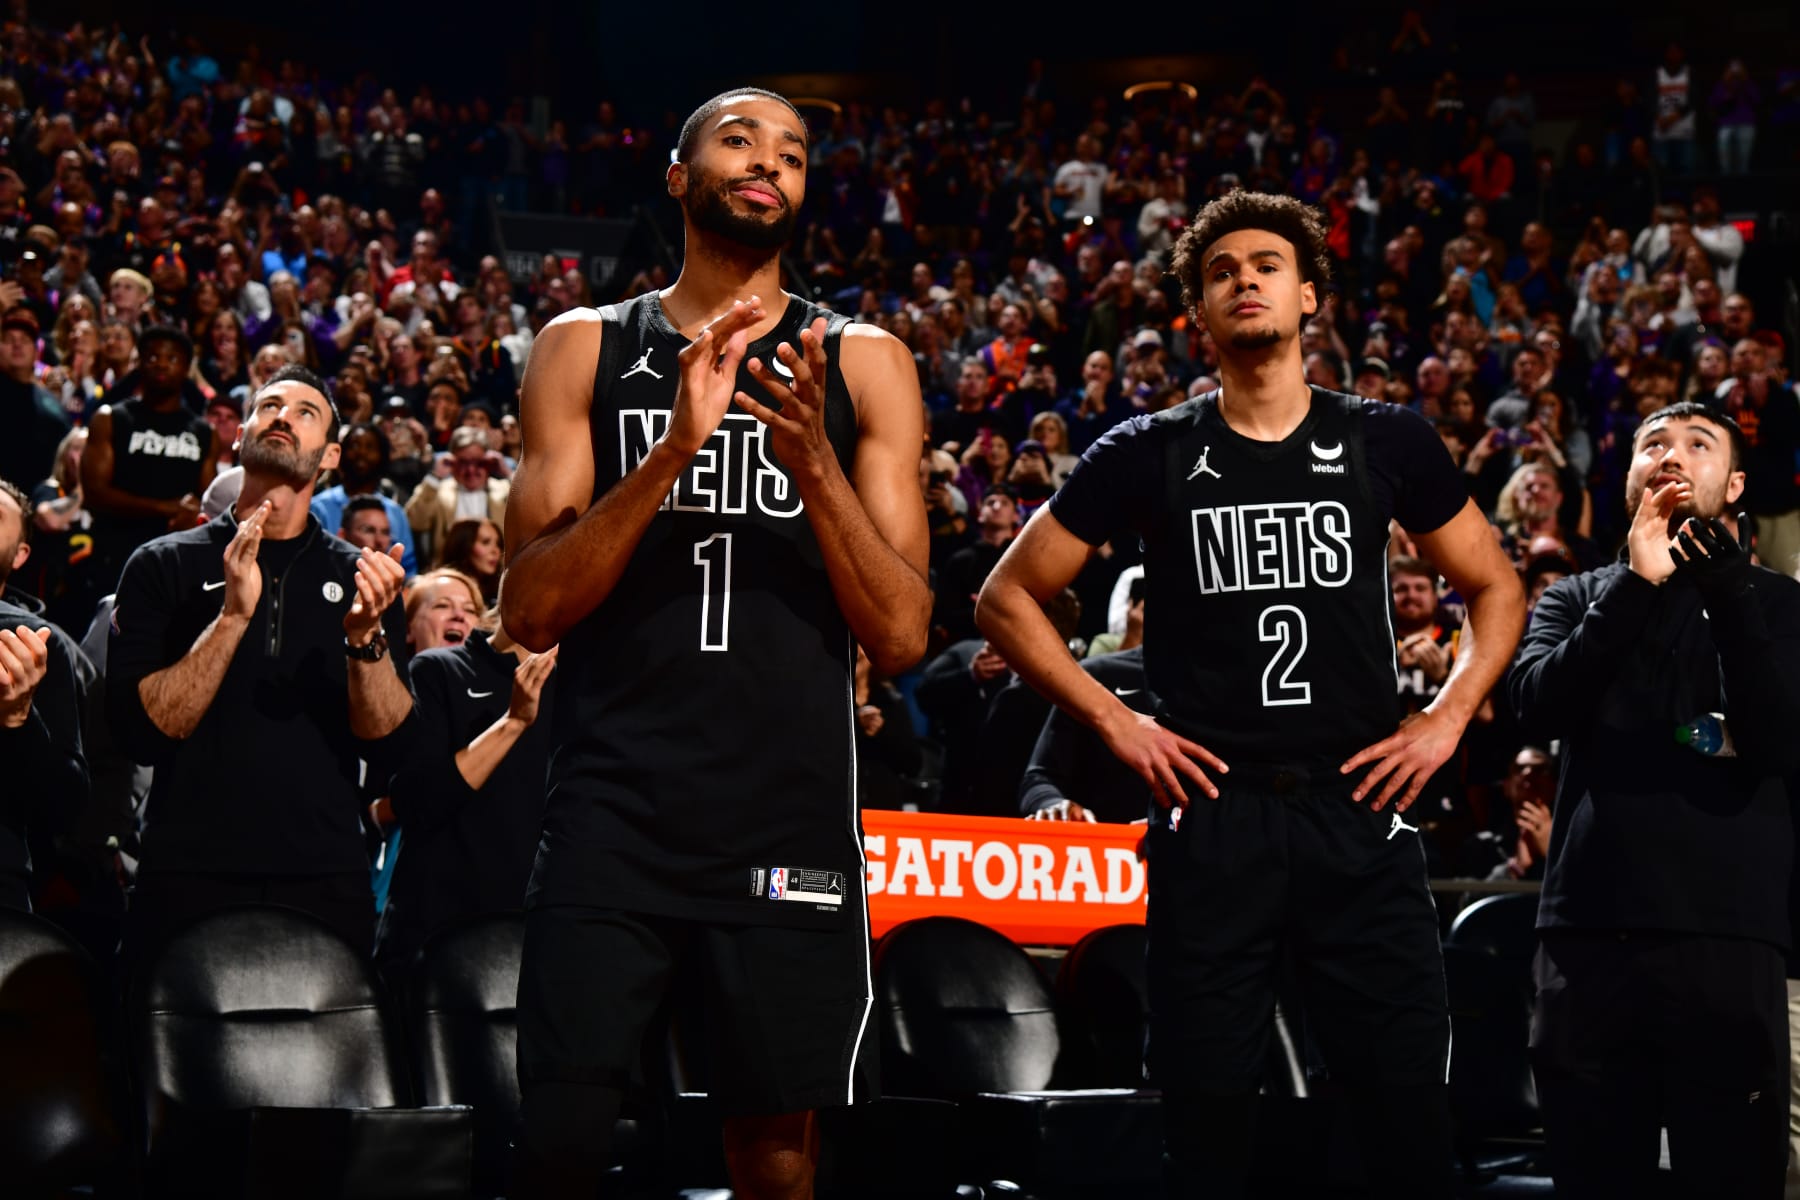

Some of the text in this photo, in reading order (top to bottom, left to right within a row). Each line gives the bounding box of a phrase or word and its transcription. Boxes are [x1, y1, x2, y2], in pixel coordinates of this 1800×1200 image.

[1312, 463, 1344, 473] Webull
[694, 533, 732, 652] 1
[1191, 501, 1352, 594] NETS
[1258, 604, 1311, 706] 2
[864, 834, 1149, 905] GATORAD
